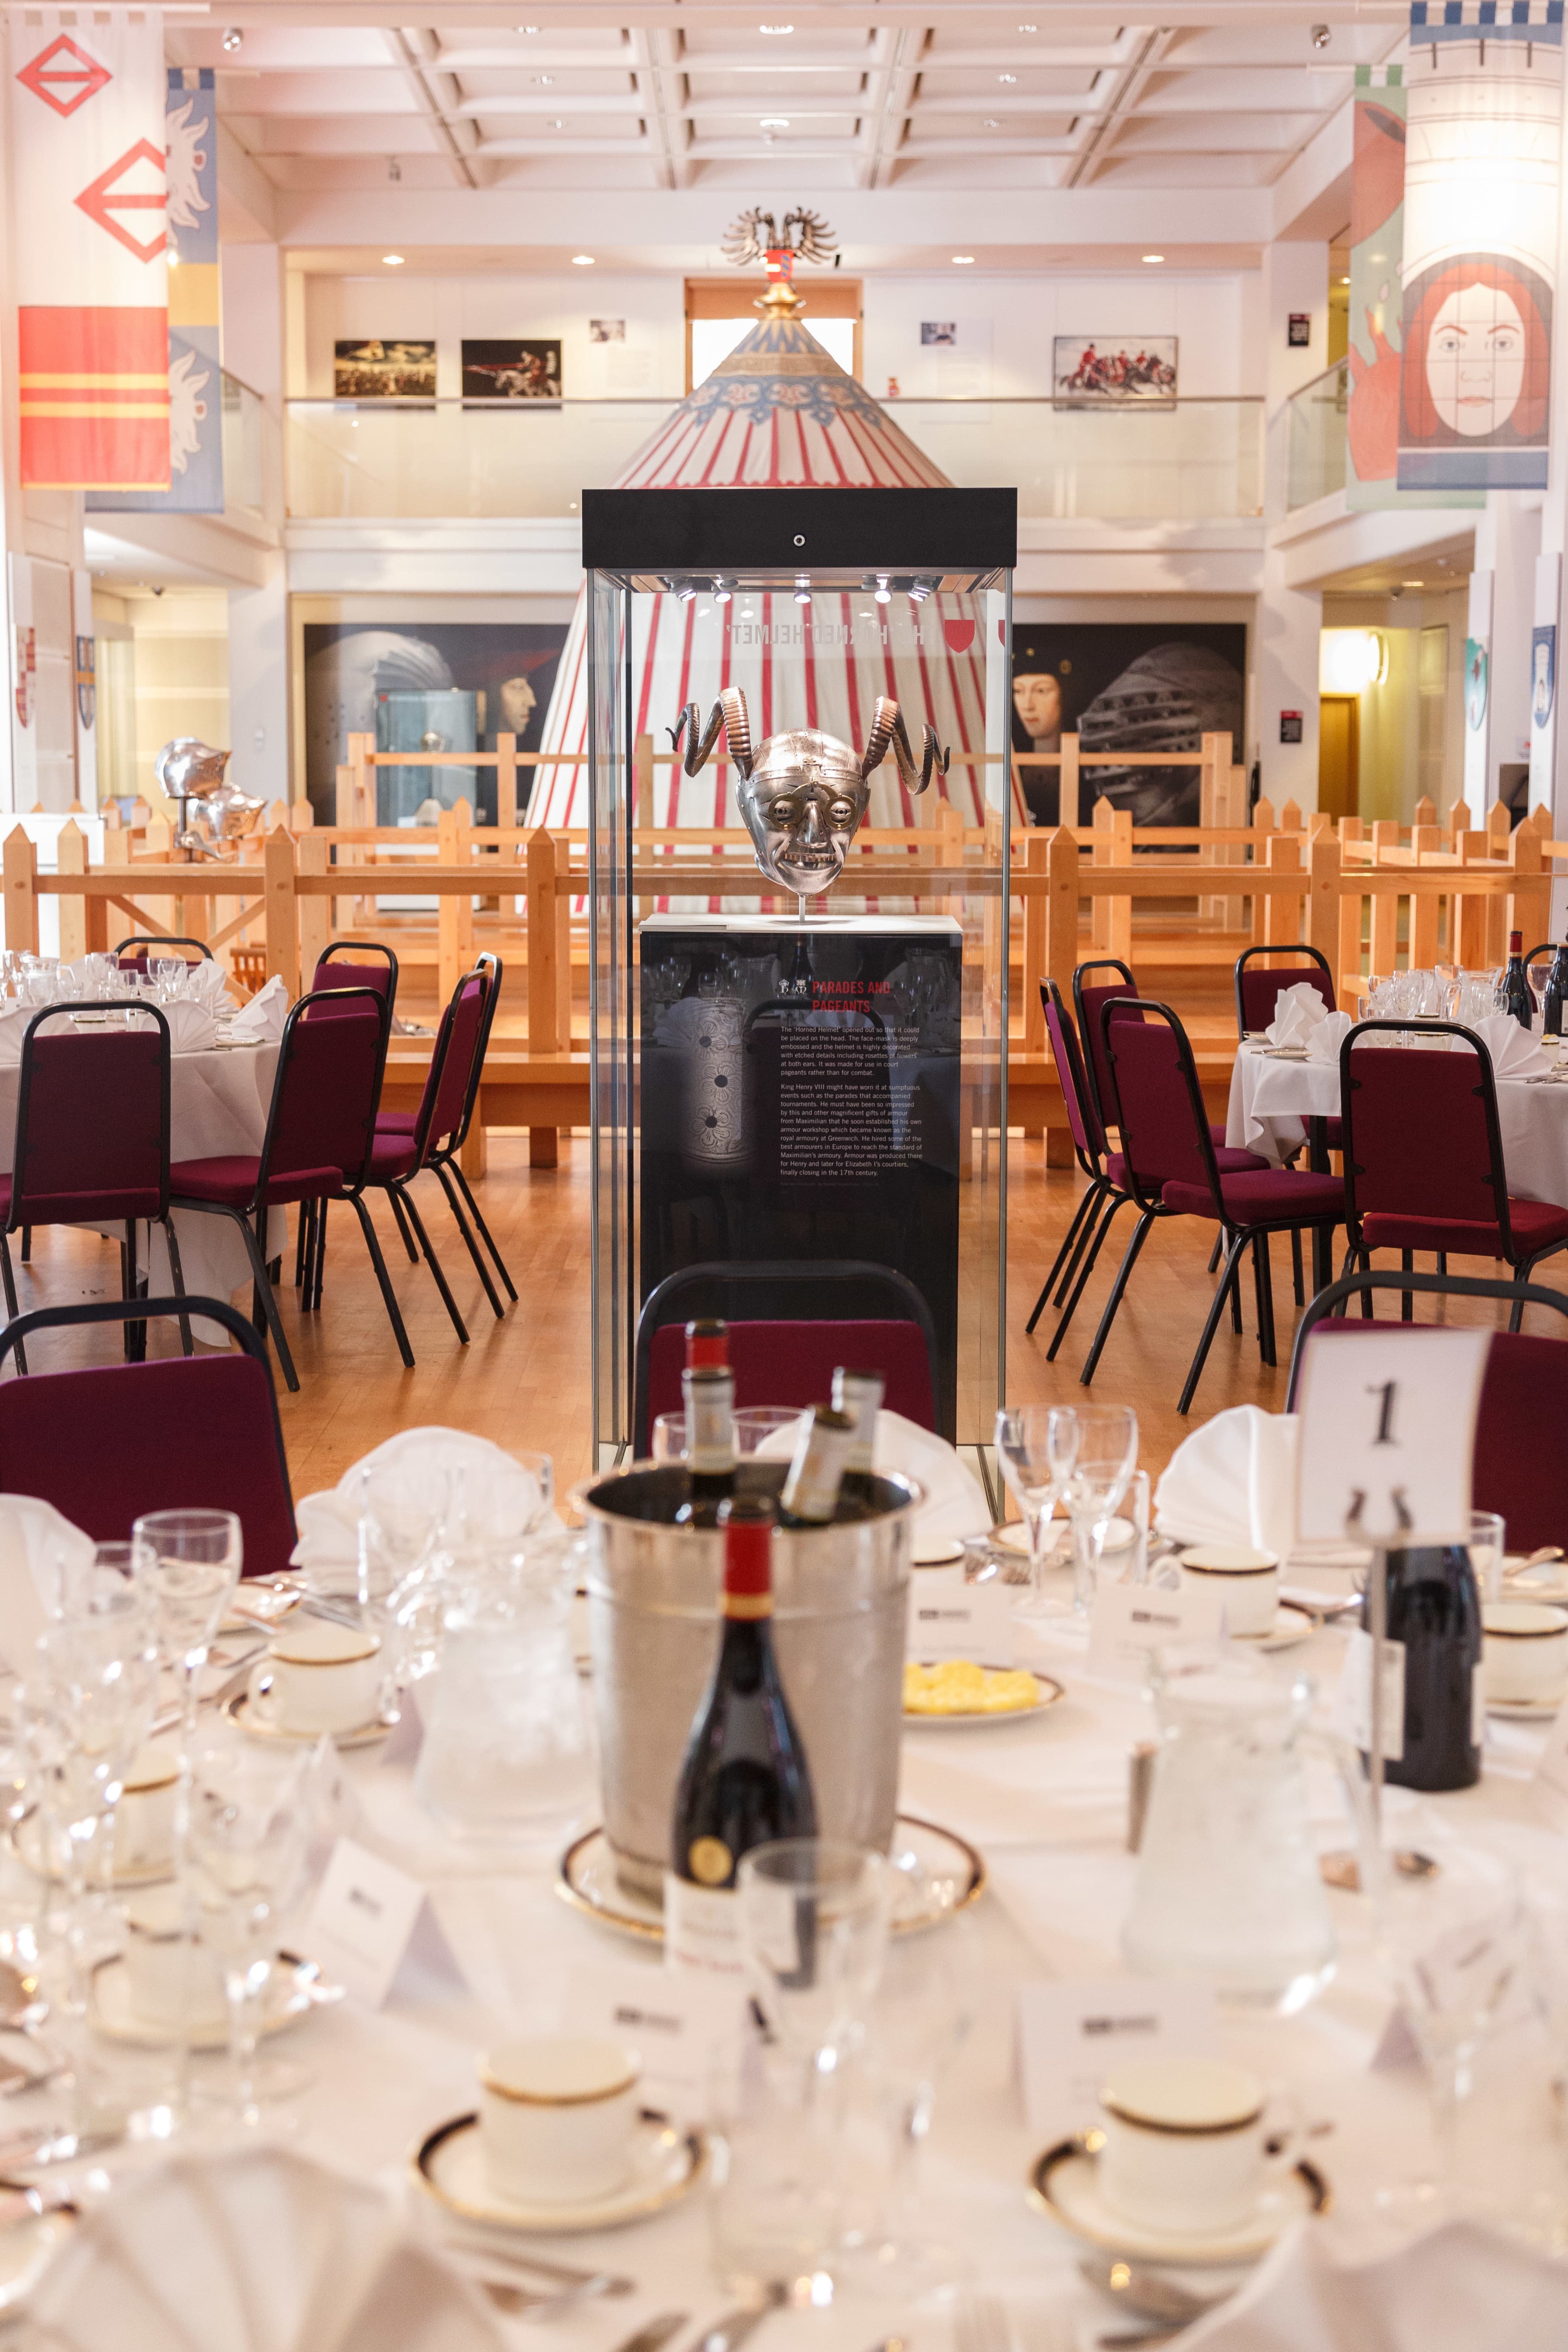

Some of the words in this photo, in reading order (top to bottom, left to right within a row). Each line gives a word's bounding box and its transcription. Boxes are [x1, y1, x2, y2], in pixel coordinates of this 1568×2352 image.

[812, 981, 864, 994] PARADES
[867, 981, 891, 994] AND
[812, 1000, 870, 1013] PAGEANTS
[1367, 1380, 1401, 1447] 1
